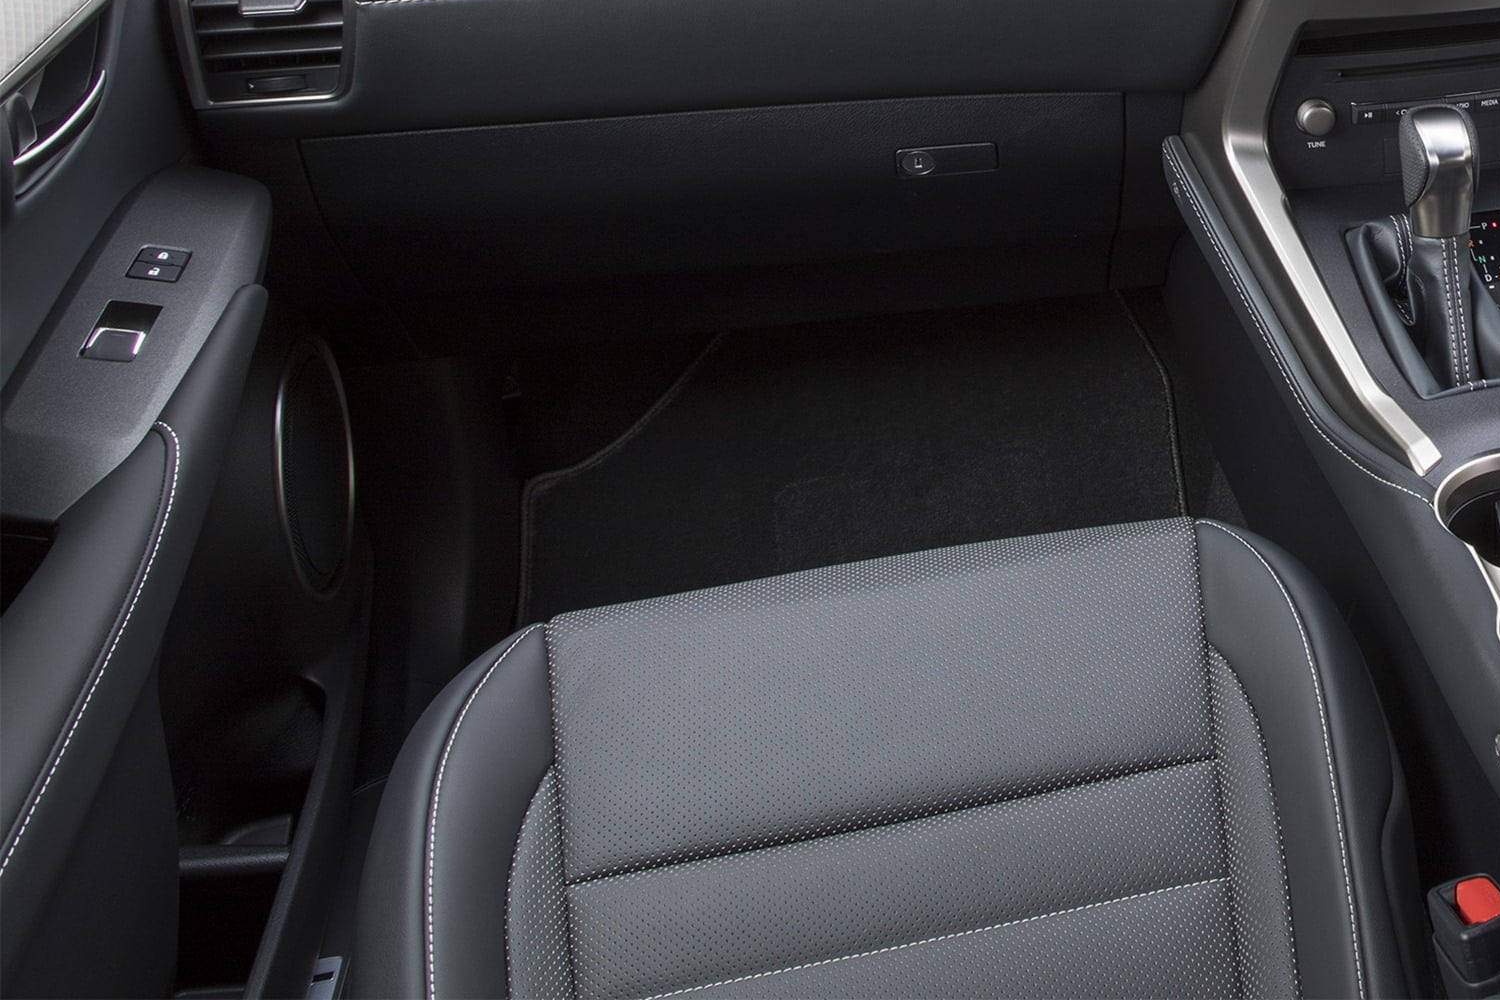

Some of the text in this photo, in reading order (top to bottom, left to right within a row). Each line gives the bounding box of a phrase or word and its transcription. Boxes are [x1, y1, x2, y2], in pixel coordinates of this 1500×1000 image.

[1480, 98, 1499, 107] MEDIA
[1307, 140, 1327, 149] TUNE
[1481, 222, 1488, 230] P
[1478, 255, 1487, 264] N
[1484, 274, 1493, 282] D
